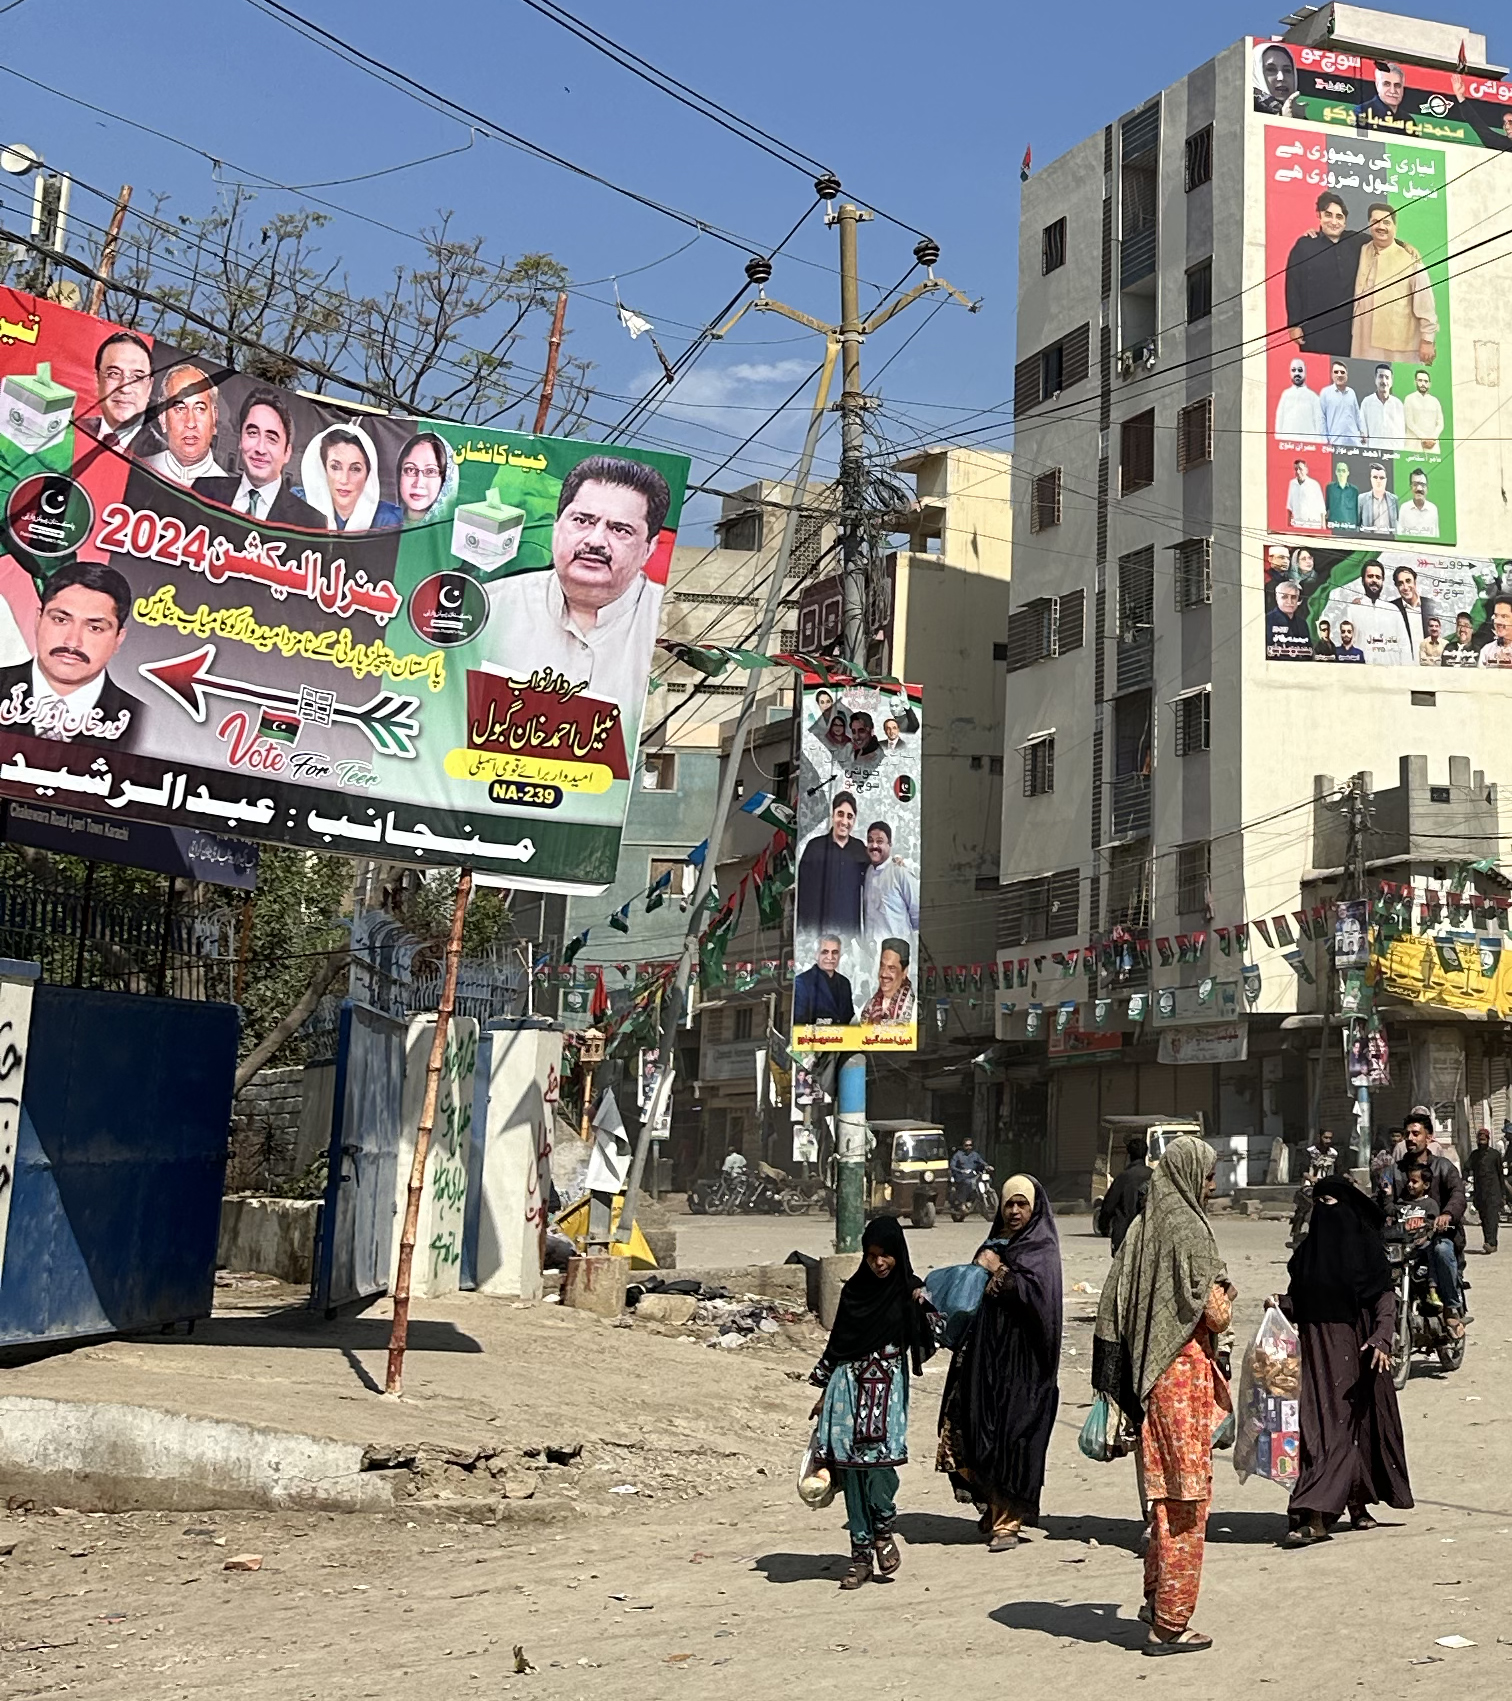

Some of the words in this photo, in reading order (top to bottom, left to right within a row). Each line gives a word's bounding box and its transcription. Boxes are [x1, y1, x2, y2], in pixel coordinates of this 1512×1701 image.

[1321, 53, 1360, 73] سوچ
[1422, 122, 1464, 138] محمد
[1275, 141, 1304, 158] ہے
[1307, 145, 1365, 166] مجبوری
[1369, 153, 1392, 170] کی
[1274, 165, 1303, 182] ہے
[1306, 168, 1360, 188] ضروری
[1395, 158, 1435, 176] لیاری
[1363, 174, 1399, 195] گبول
[1403, 180, 1438, 200] نبیل
[453, 440, 492, 464] نشان
[492, 444, 509, 464] کا
[508, 449, 548, 475] جیت
[96, 505, 210, 571] 2024
[206, 531, 320, 600] الیکشن
[318, 558, 402, 625] جنرل
[136, 588, 177, 622] بنائیں
[177, 608, 233, 635] کامیاب
[234, 618, 288, 648] امیدوار
[284, 632, 313, 654] نامزد
[312, 633, 336, 657] کے
[336, 630, 364, 675] پارٹی
[365, 641, 392, 673] پیپلز
[391, 654, 443, 689] پاکستان
[507, 666, 553, 697] نواب
[548, 672, 589, 703] سردار
[63, 708, 104, 736] خان
[98, 710, 131, 738] نور
[471, 698, 525, 745] گبول
[510, 713, 548, 750] خان
[573, 708, 622, 758] نبیل
[216, 711, 286, 774] Vote
[289, 751, 332, 780] For
[334, 759, 382, 787] Teer
[542, 722, 577, 750] احمد
[496, 757, 521, 778] قومی
[518, 765, 552, 783] برائے
[552, 769, 594, 788] امیدوار
[492, 783, 556, 804] NA-239
[306, 806, 538, 866] منجانب
